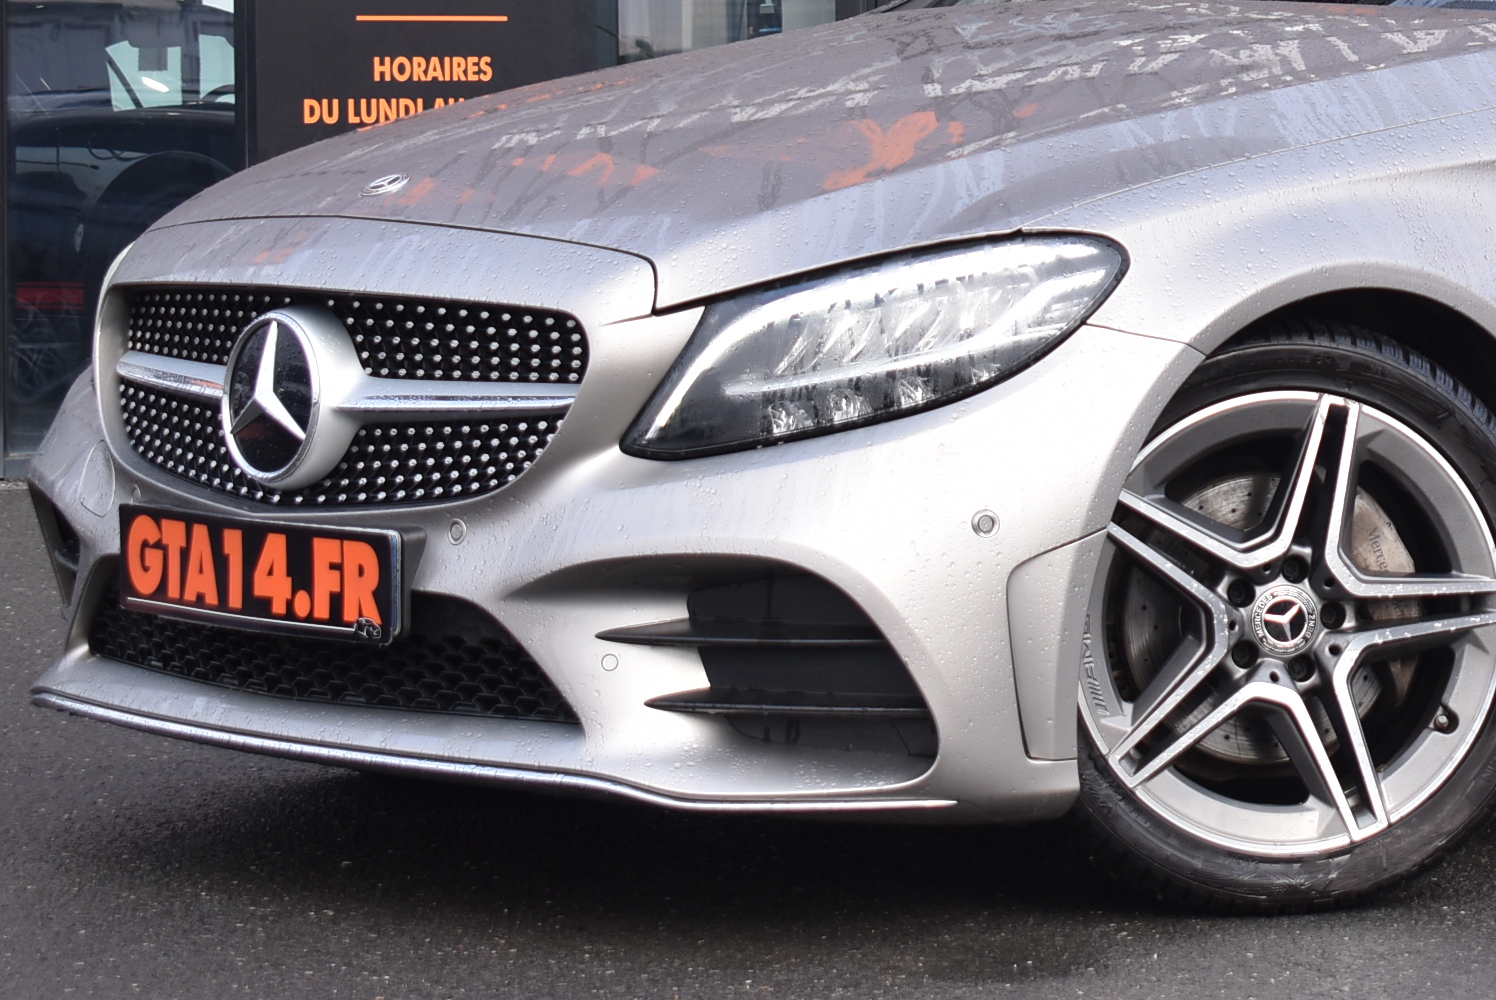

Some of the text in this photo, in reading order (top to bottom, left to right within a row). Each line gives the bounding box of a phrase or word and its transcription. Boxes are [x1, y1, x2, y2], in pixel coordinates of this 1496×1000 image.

[373, 55, 493, 82] HORAIRES
[303, 98, 340, 125] DU
[127, 514, 383, 626] GTA14.FR
[1367, 526, 1389, 572] Merce
[1254, 593, 1316, 639] MERCEDES BENZ
